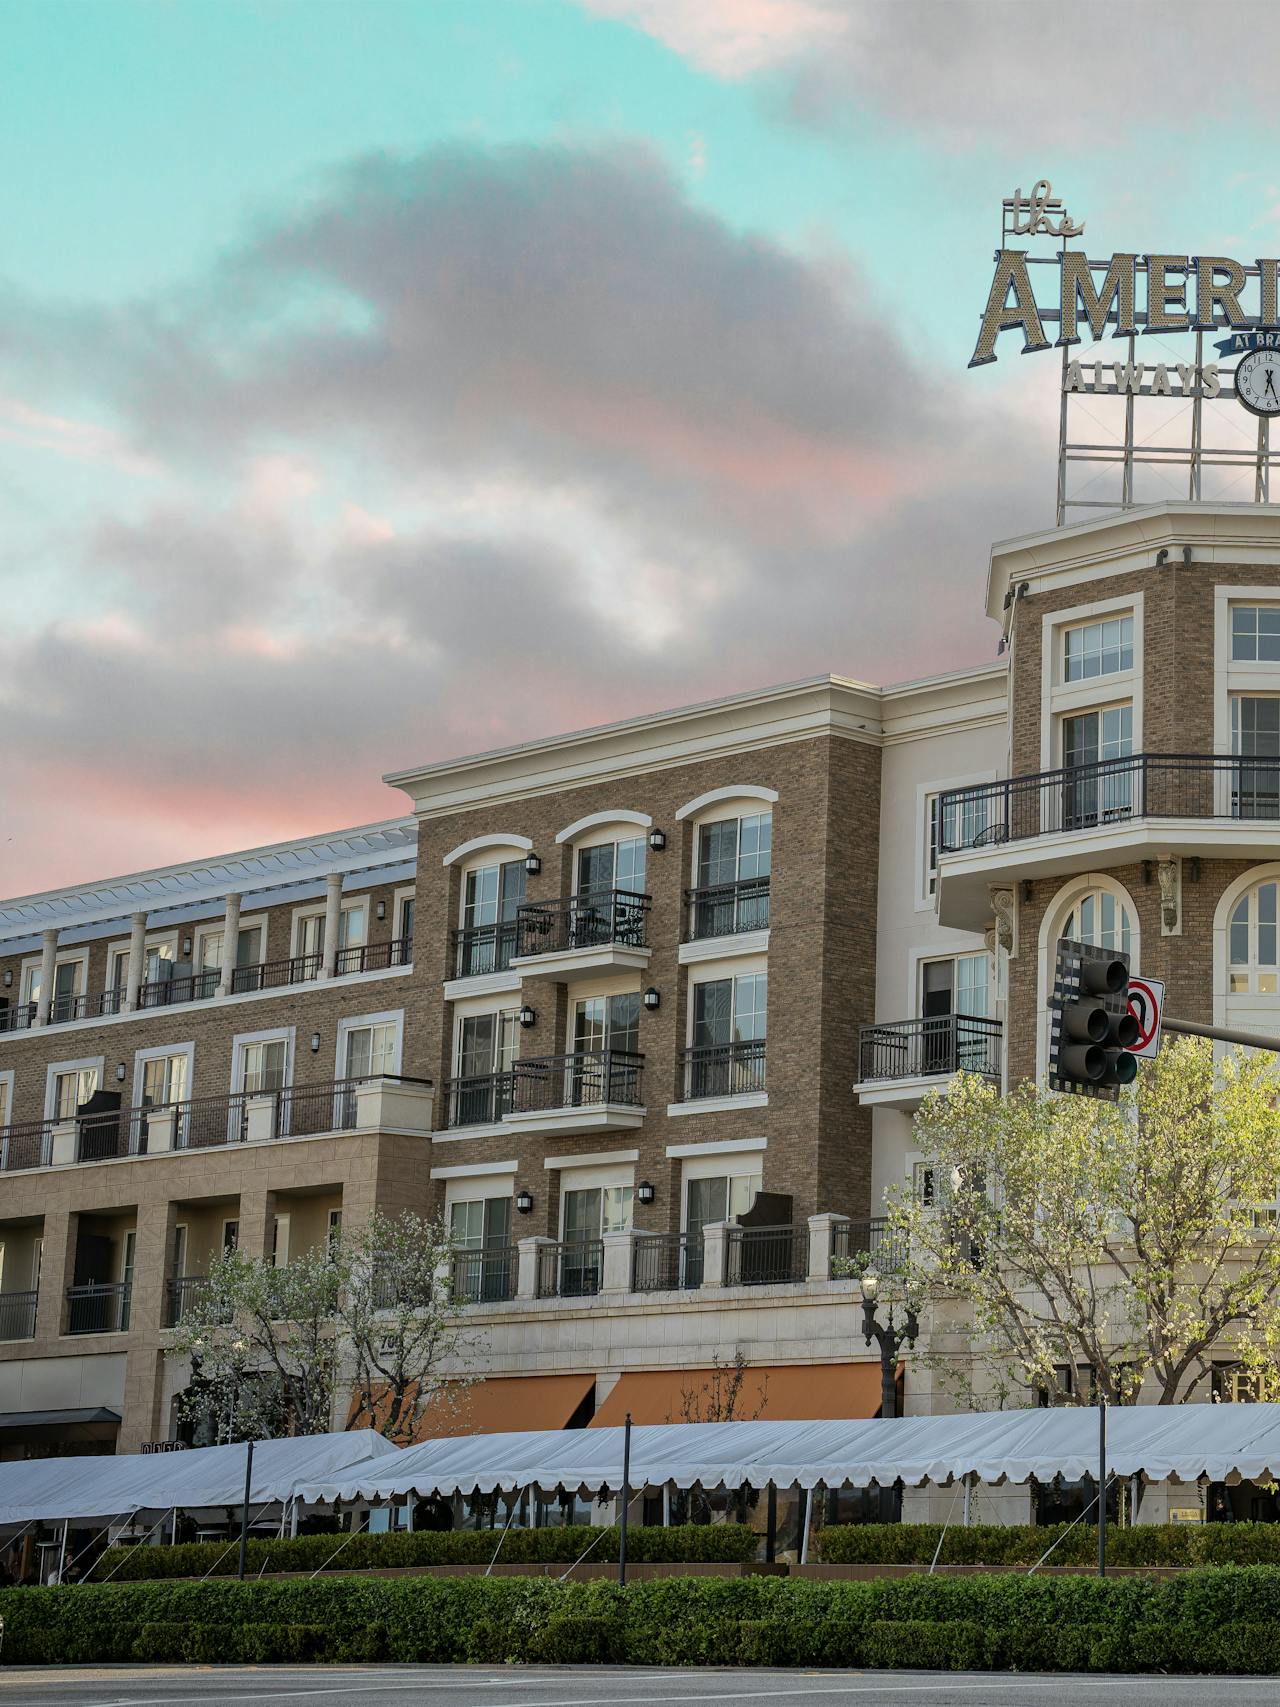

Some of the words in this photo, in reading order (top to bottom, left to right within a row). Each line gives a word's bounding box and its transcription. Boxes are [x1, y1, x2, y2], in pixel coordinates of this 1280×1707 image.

[1002, 179, 1085, 236] the
[1235, 335, 1250, 349] AT
[1064, 359, 1221, 399] ALWAYS
[1243, 365, 1252, 373] 10
